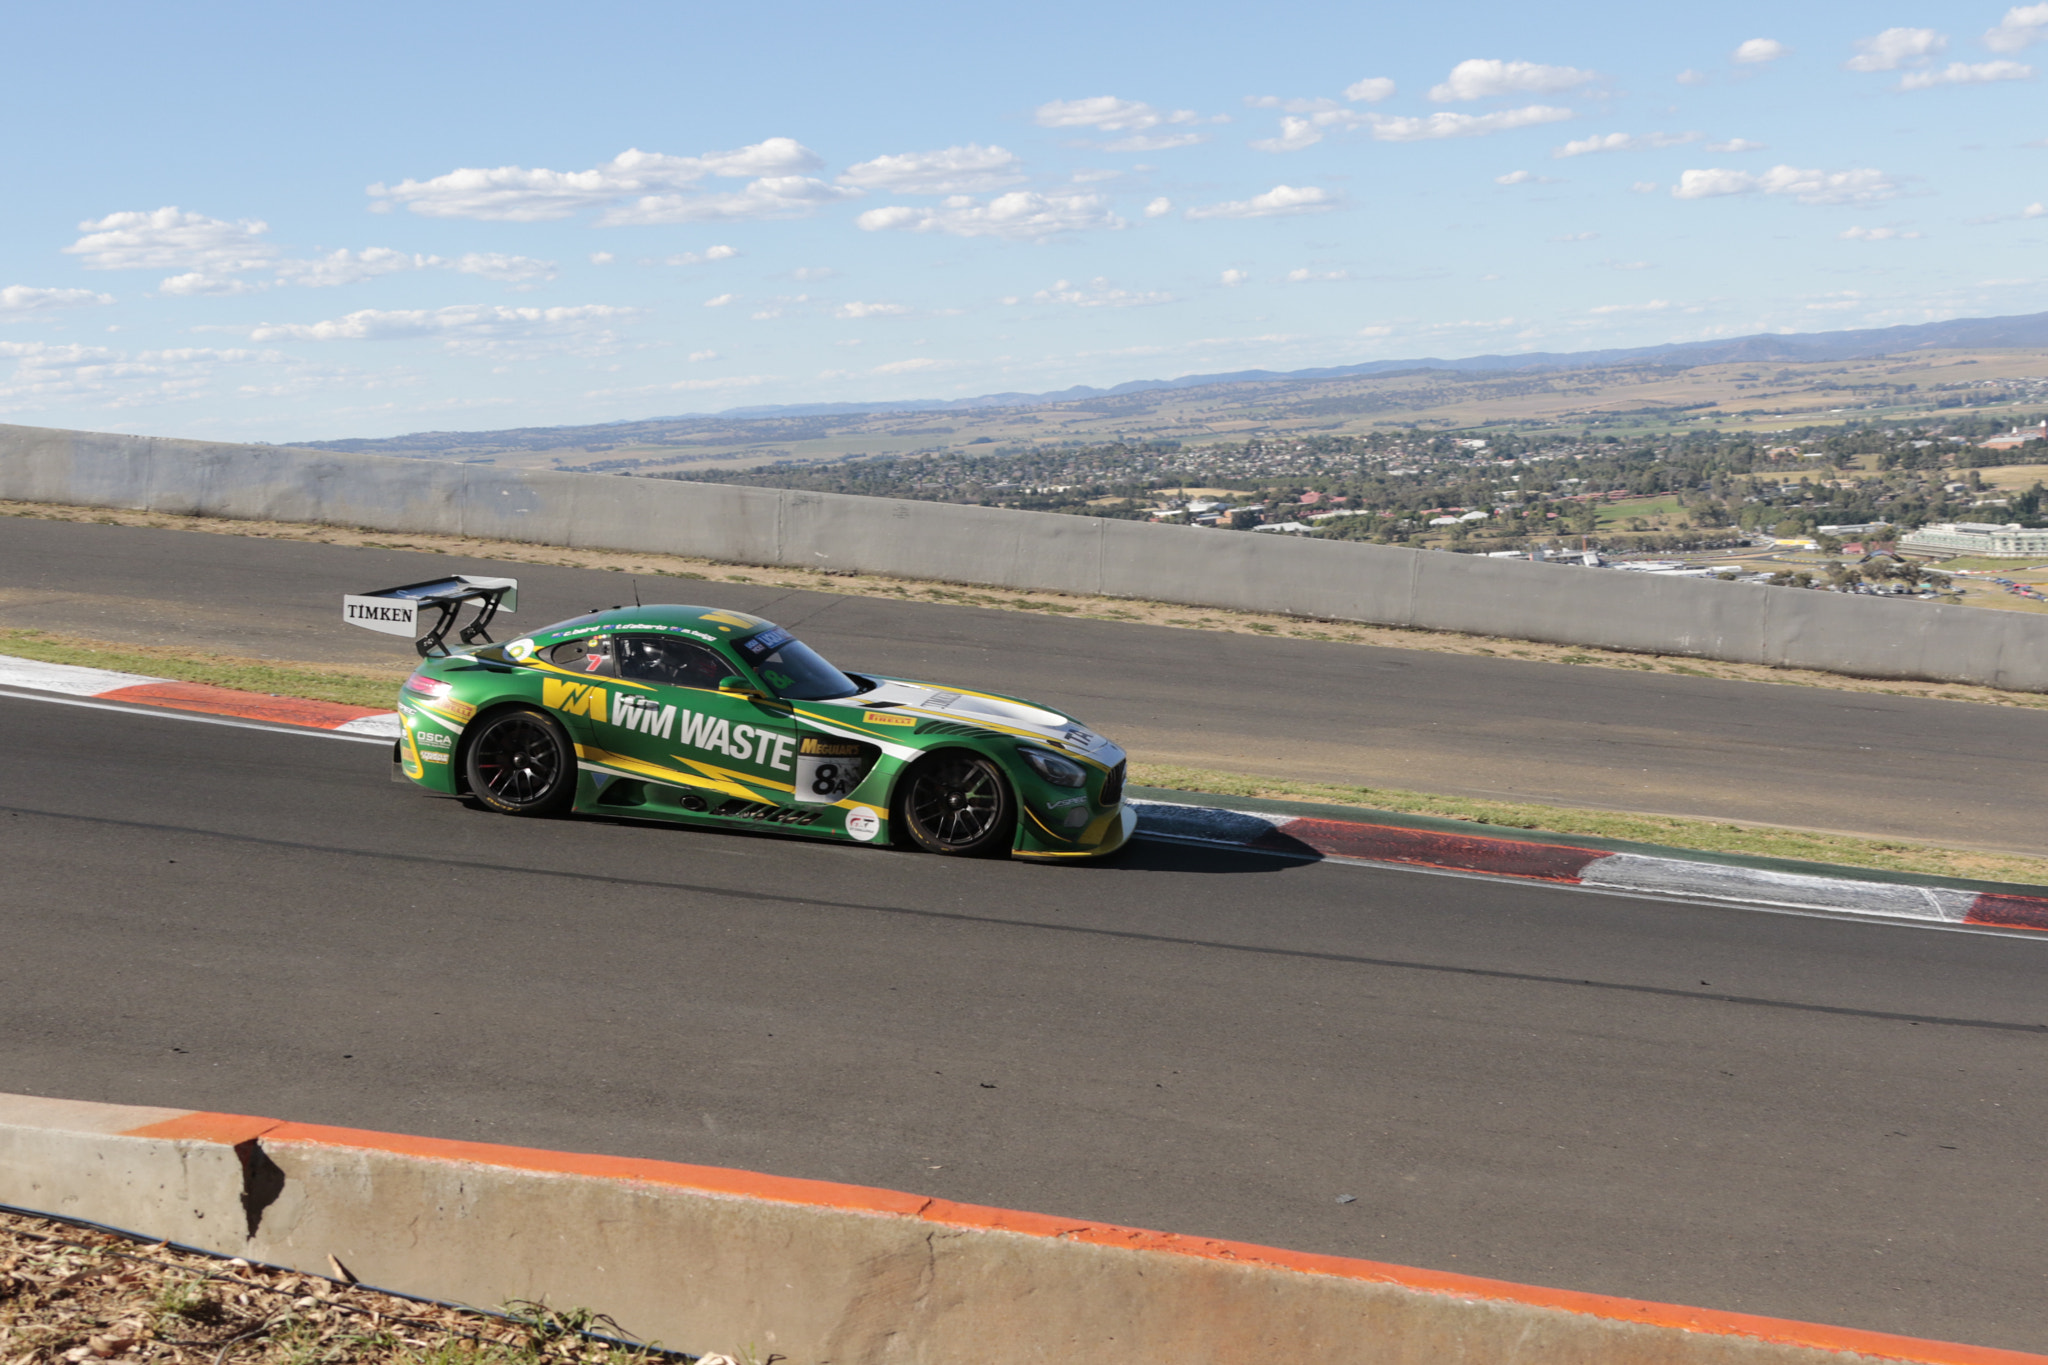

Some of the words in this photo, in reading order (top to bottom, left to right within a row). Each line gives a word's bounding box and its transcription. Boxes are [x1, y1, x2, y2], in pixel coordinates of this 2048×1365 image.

[347, 604, 412, 623] TIMKEN
[585, 653, 602, 672] 7
[868, 713, 912, 725] PIRELLI
[417, 731, 452, 744] OSCA
[611, 691, 677, 740] WM
[681, 709, 797, 772] WASTE
[812, 763, 846, 796] 8A
